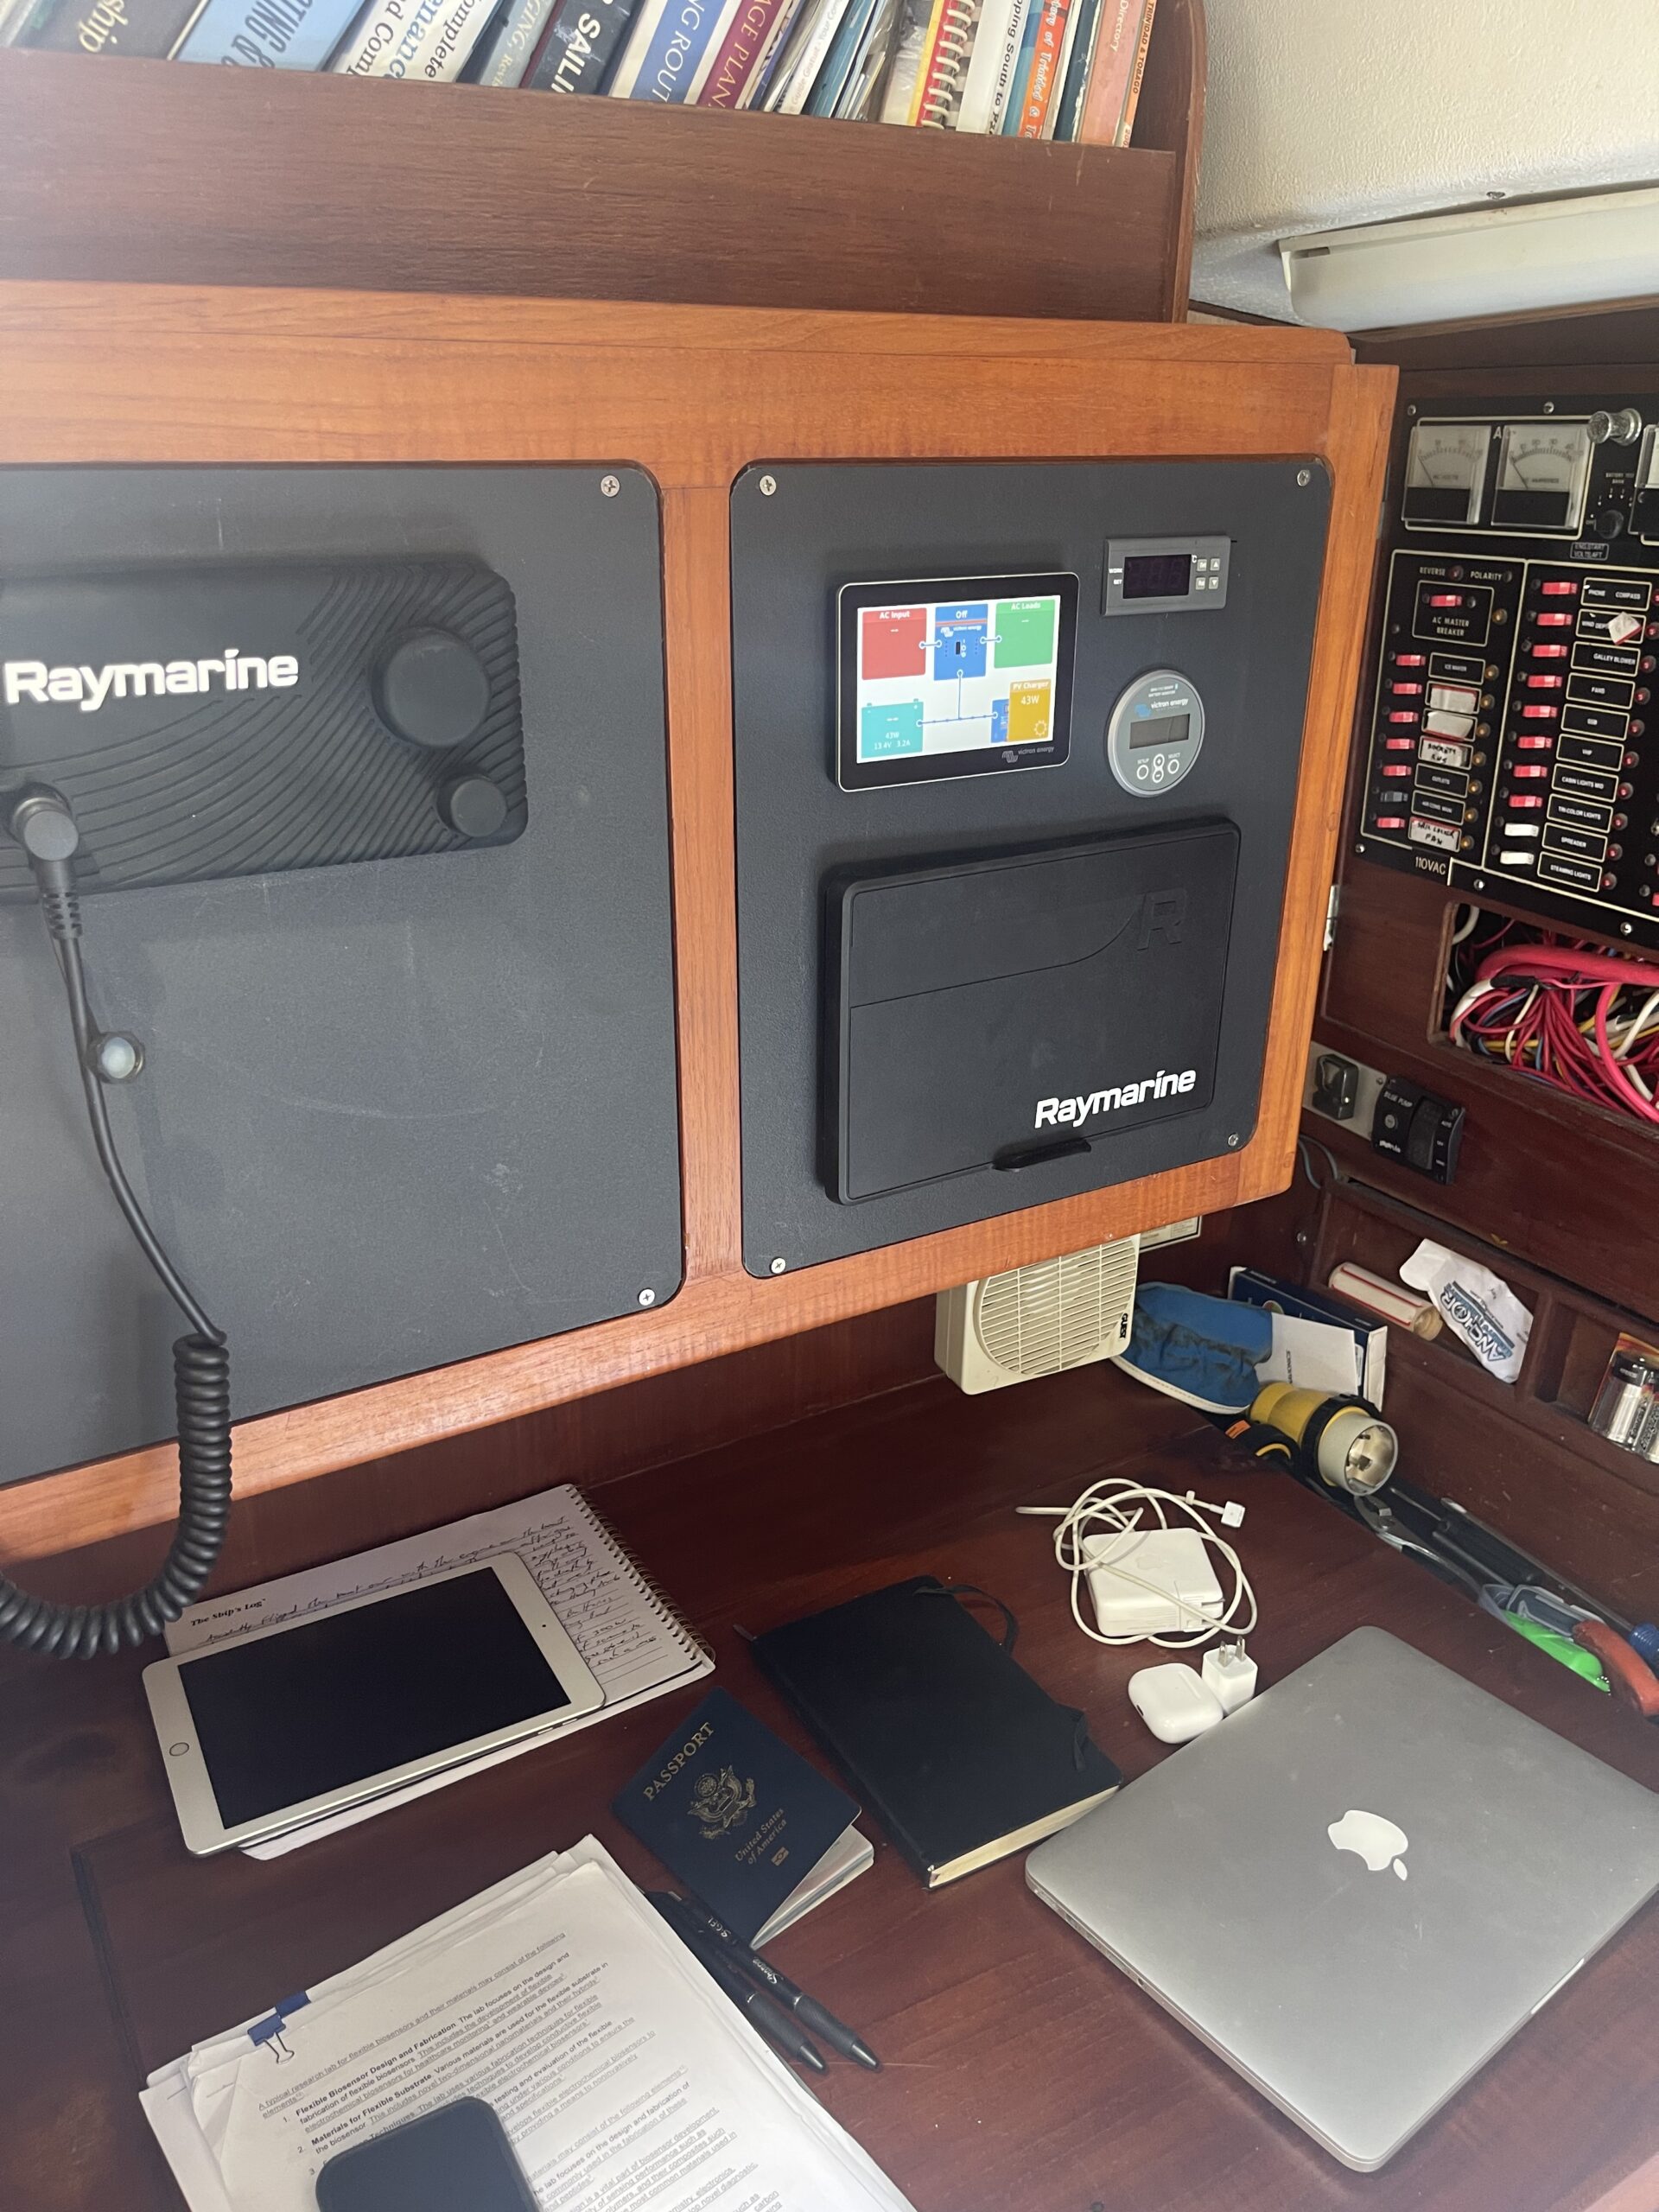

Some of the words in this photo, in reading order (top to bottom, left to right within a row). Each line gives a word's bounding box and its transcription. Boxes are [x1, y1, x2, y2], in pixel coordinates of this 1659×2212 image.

[999, 43, 1014, 86] South
[1033, 53, 1052, 102] Trinidad
[1133, 57, 1145, 94] TOBAGO
[995, 93, 1003, 105] to
[1029, 105, 1039, 118] &
[1420, 567, 1445, 576] REVERSE
[1471, 571, 1503, 581] POLARITY
[1021, 601, 1041, 610] Loads
[880, 611, 890, 620] AC
[892, 611, 910, 620] Input
[956, 610, 968, 619] Off
[1445, 617, 1469, 627] MASTER
[1437, 627, 1464, 636] BREAKER
[3, 649, 299, 712] Raymarine
[1023, 681, 1049, 690] Charger
[1020, 695, 1039, 705] 43W
[1151, 700, 1169, 709] victron
[1037, 746, 1054, 754] energy
[1577, 779, 1594, 788] LIGHTS
[1584, 811, 1601, 820] LIGHTS
[1561, 836, 1586, 848] SPREADER
[1415, 856, 1446, 875] 110VAC
[1550, 864, 1573, 876] STEAMING
[1574, 871, 1592, 880] LIGHTS
[1035, 1070, 1196, 1128] Raymarine
[1440, 1291, 1506, 1362] ANCHOR
[189, 1615, 210, 1627] The
[643, 1721, 714, 1802] PASSPORT
[734, 1830, 762, 1862] United
[760, 1808, 785, 1836] States
[747, 1851, 757, 1866] of
[754, 1818, 787, 1856] America
[264, 2088, 291, 2107] typical
[290, 2070, 323, 2093] research
[323, 2063, 337, 2074] lab
[336, 2056, 349, 2066] for
[348, 2041, 375, 2060] flexible
[375, 2019, 414, 2045] biosensors
[414, 2012, 429, 2024] and
[429, 2002, 446, 2016] their
[445, 1983, 477, 2005] materials
[477, 1974, 493, 1987] may
[493, 1960, 518, 1978] consist
[516, 1955, 525, 1963] of
[524, 1948, 537, 1959] the
[535, 1930, 566, 1953] following
[295, 2094, 327, 2116] Flexible
[327, 2070, 370, 2098] Biosensor
[369, 2055, 398, 2075] Design
[397, 2046, 413, 2059] and
[457, 2011, 474, 2024] The
[472, 2004, 485, 2015] lab
[484, 1987, 512, 2008] focuses
[512, 1982, 523, 1991] on
[521, 1974, 534, 1985] the
[532, 1960, 557, 1979] design
[555, 1951, 569, 1963] and
[298, 2097, 340, 2125] fabrication
[339, 2092, 350, 2102] of
[347, 2077, 375, 2097] flexible
[434, 2027, 464, 2048] includes
[475, 1993, 521, 2024] development
[527, 1973, 552, 1991] flexible
[309, 2119, 350, 2146] Materials
[347, 2112, 363, 2125] for
[361, 2094, 395, 2117] Flexible
[433, 2053, 463, 2075] Various
[461, 2035, 494, 2058] materials
[494, 2028, 506, 2038] are
[505, 2016, 525, 2031] used
[524, 2009, 536, 2019] for
[534, 2001, 548, 2012] the
[545, 1986, 571, 2004] flexible
[569, 1964, 601, 1988] substrate
[493, 2084, 519, 2105] testing
[518, 2074, 533, 2087] and
[531, 2050, 569, 2077] evaluation
[568, 2044, 577, 2053] of
[575, 2036, 588, 2047] the
[587, 2019, 613, 2039] flexible
